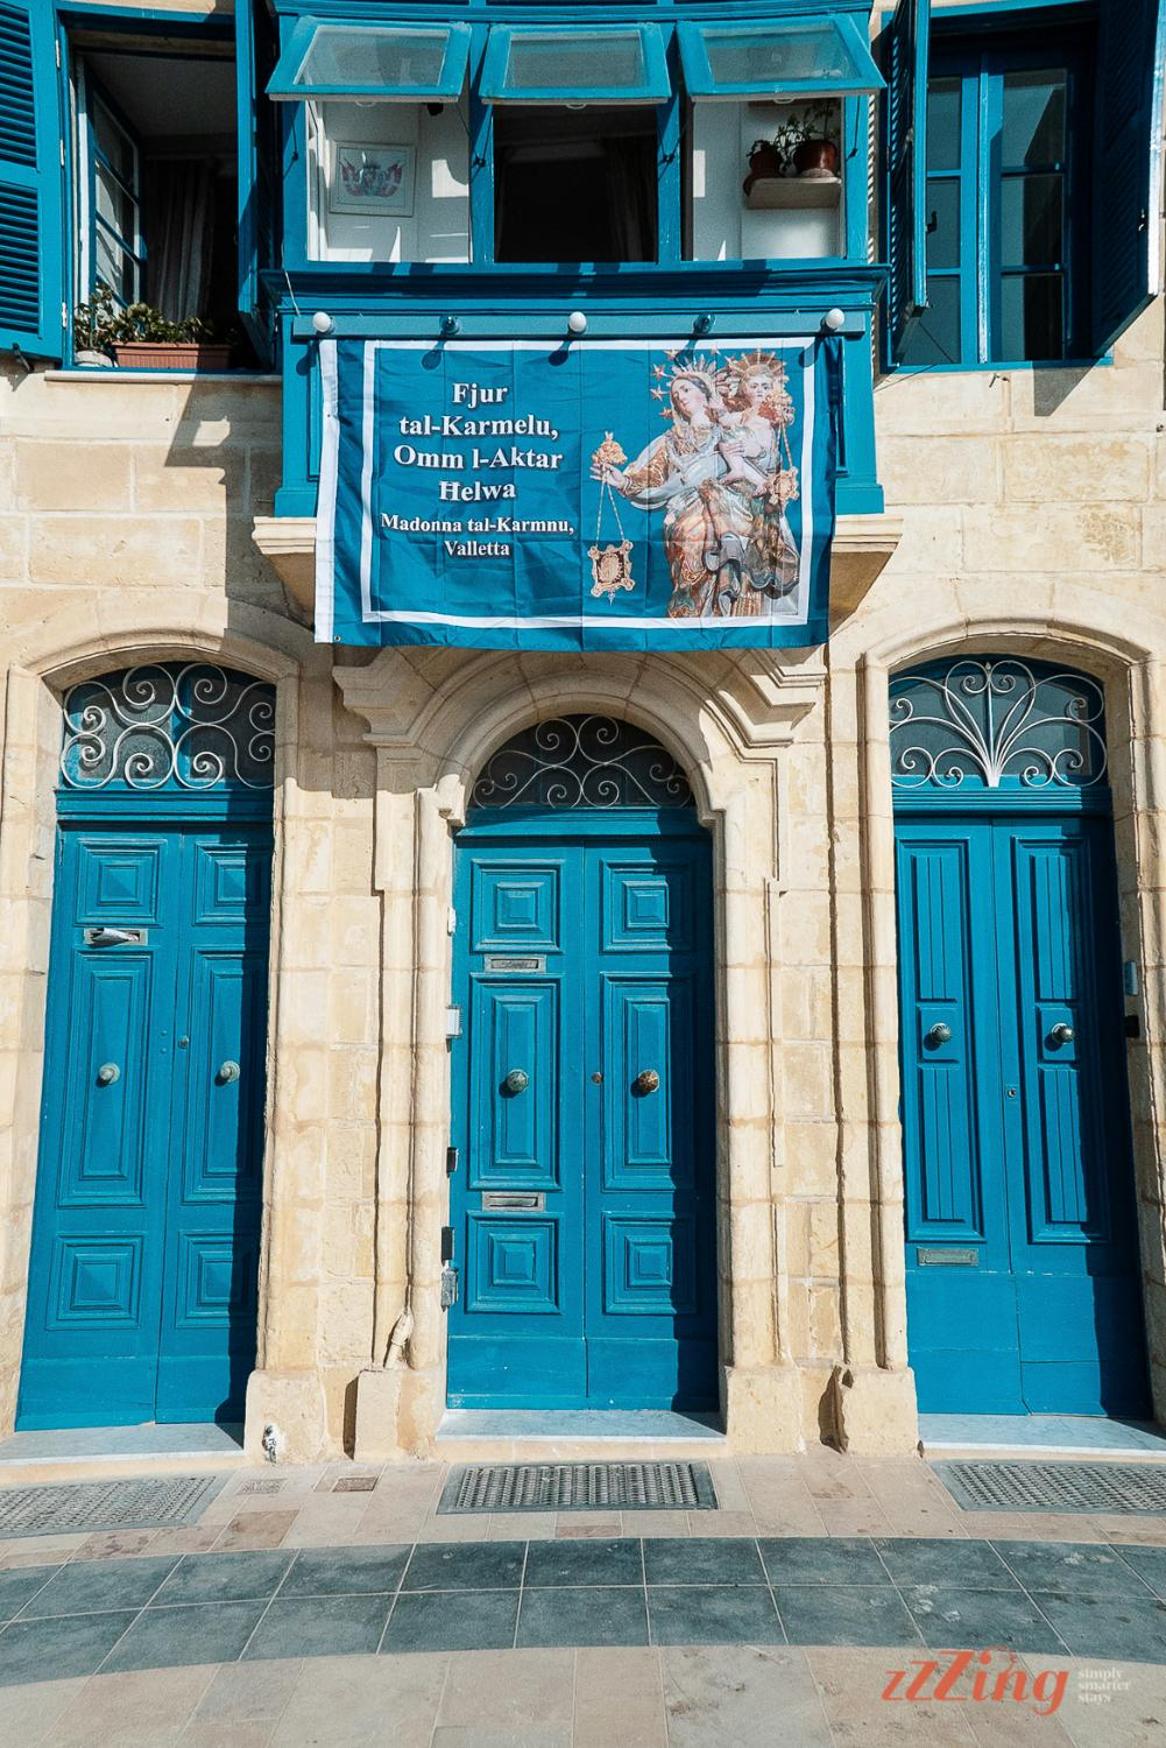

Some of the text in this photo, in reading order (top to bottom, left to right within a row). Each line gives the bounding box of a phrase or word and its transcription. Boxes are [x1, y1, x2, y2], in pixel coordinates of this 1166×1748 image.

[452, 382, 508, 408] Fjur
[399, 414, 559, 440] tal-Karmelu,
[394, 444, 563, 469] Omm l-Aktar
[381, 512, 574, 534] Madonna tal-Karmnu,
[444, 539, 510, 556] Valletta
